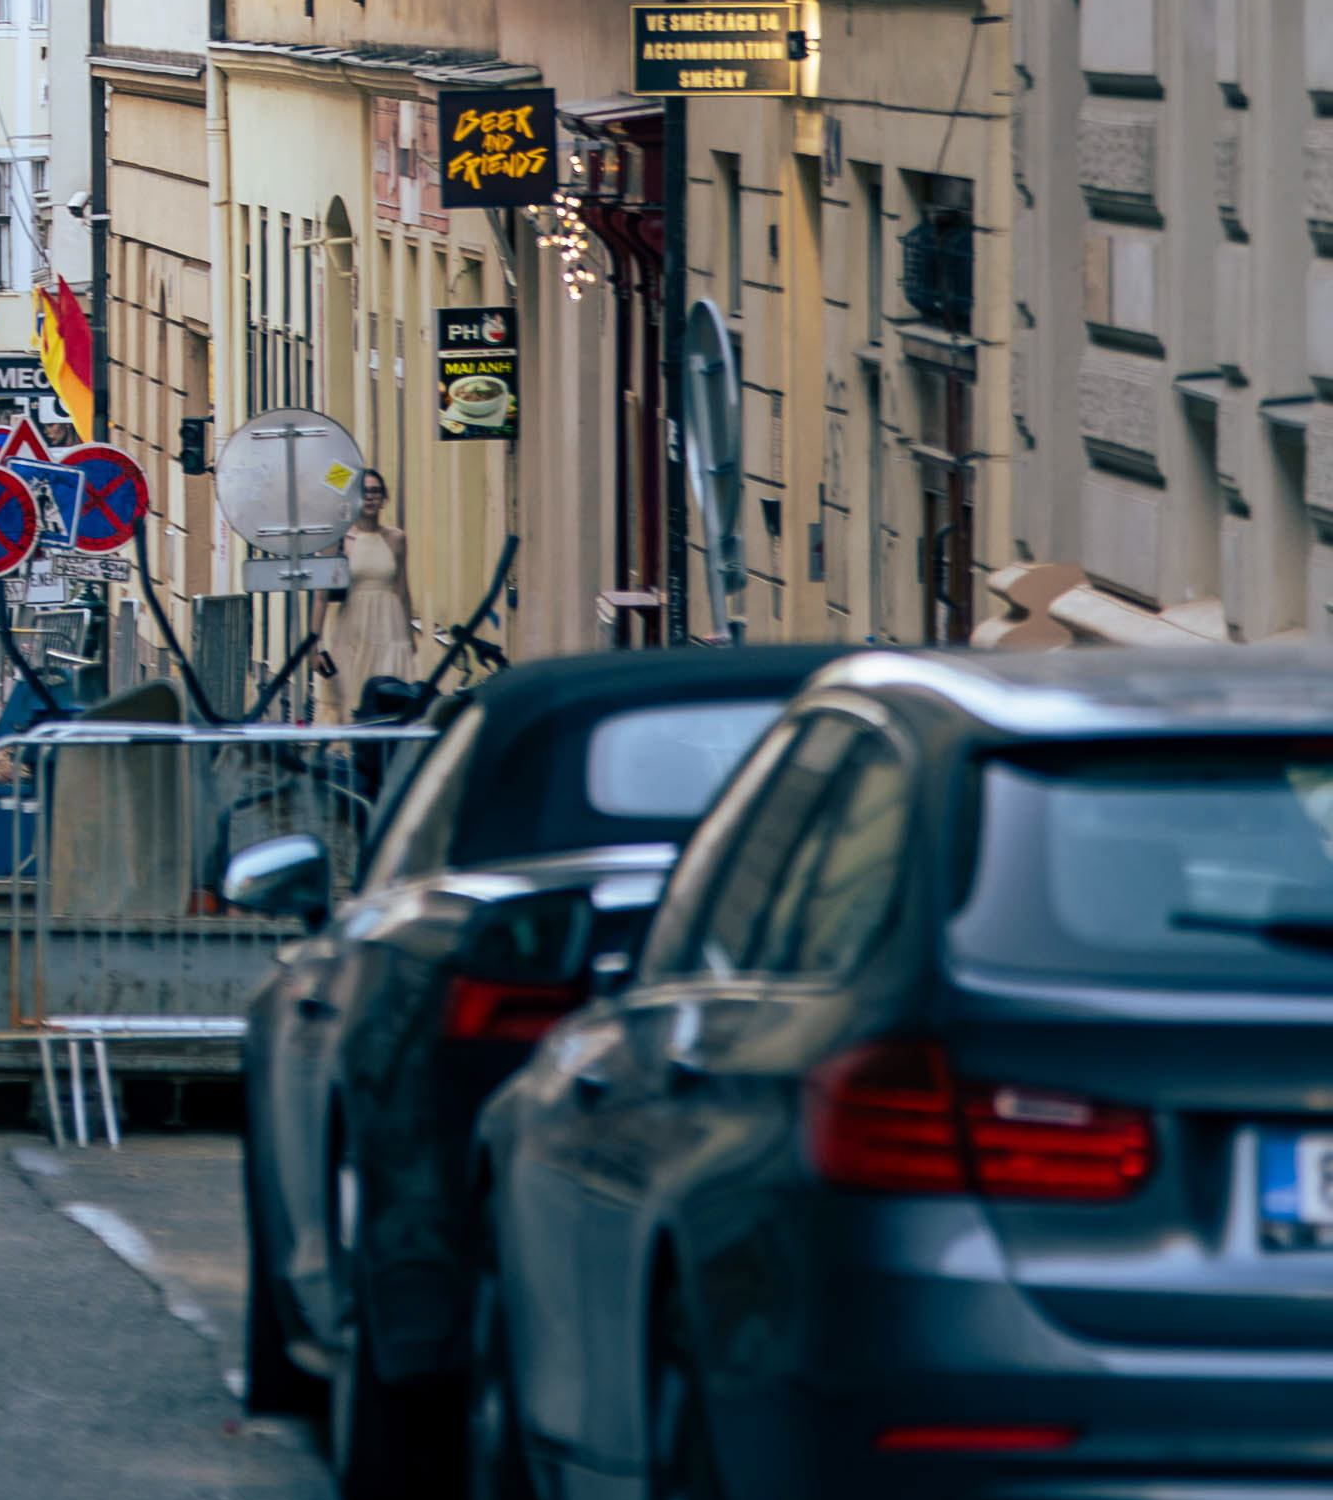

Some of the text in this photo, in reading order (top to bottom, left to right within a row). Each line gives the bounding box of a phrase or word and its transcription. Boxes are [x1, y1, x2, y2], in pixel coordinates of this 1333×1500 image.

[645, 14, 668, 32] VE
[642, 41, 783, 61] ACCOMMODATION
[678, 66, 748, 88] SMEČKY
[452, 105, 534, 142] BEER
[481, 133, 515, 153] AND
[447, 147, 549, 190] FRIENDS
[476, 361, 513, 374] ANH
